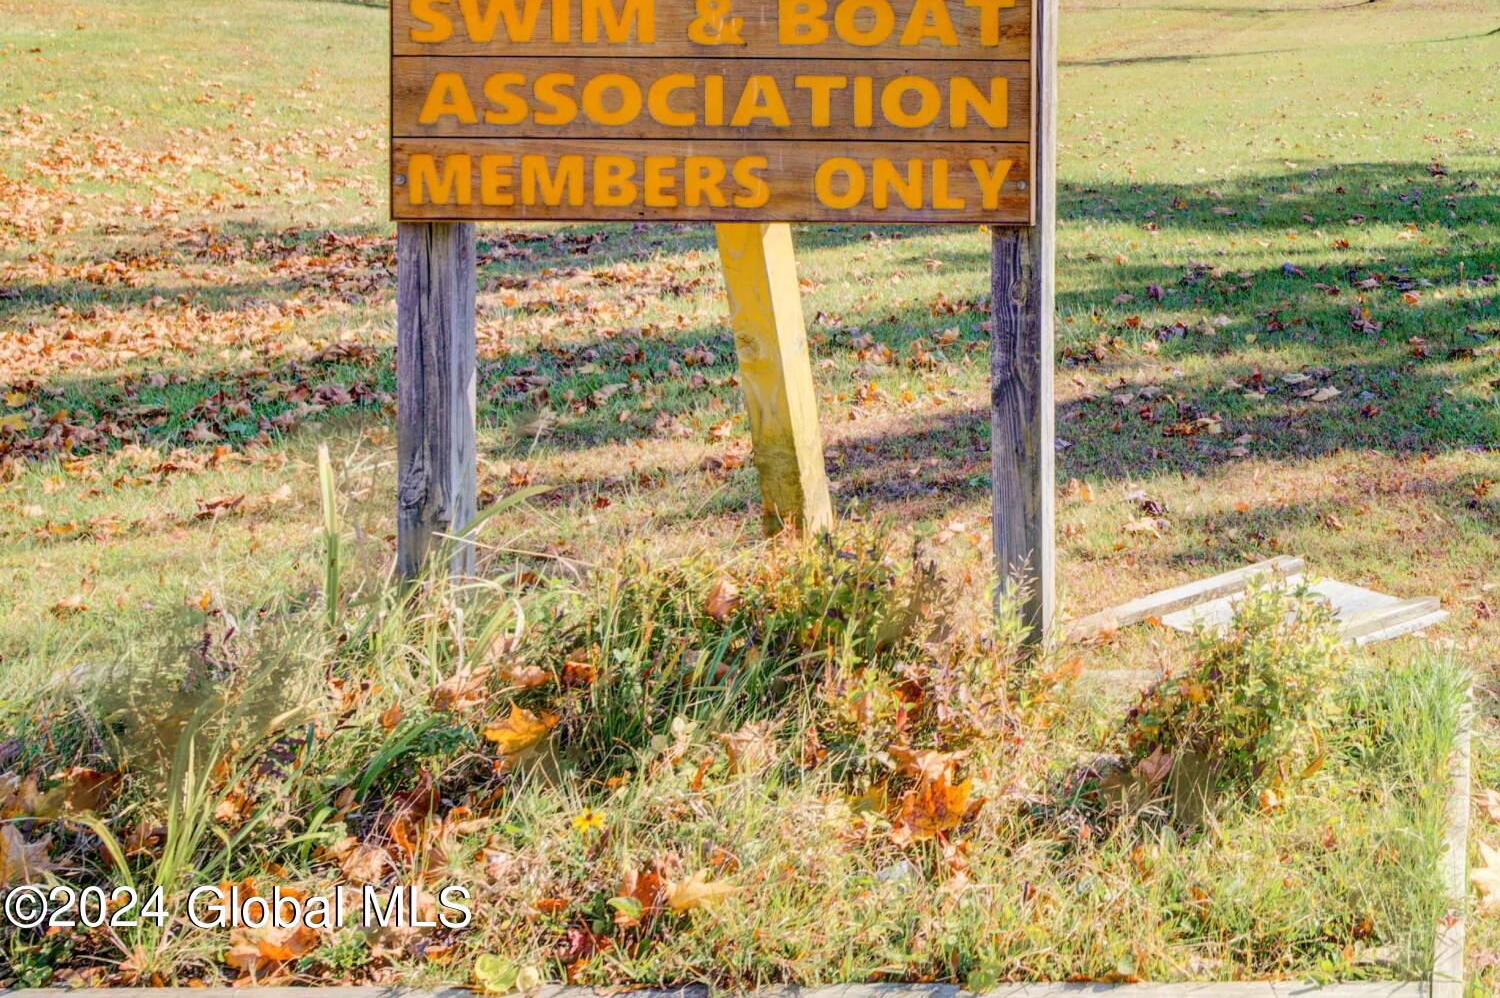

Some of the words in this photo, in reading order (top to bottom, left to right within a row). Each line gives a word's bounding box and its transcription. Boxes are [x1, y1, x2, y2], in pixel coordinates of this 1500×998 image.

[418, 72, 1009, 128] ASSOCIATION
[407, 153, 772, 208] MEMBERS
[814, 156, 1013, 211] ONLY
